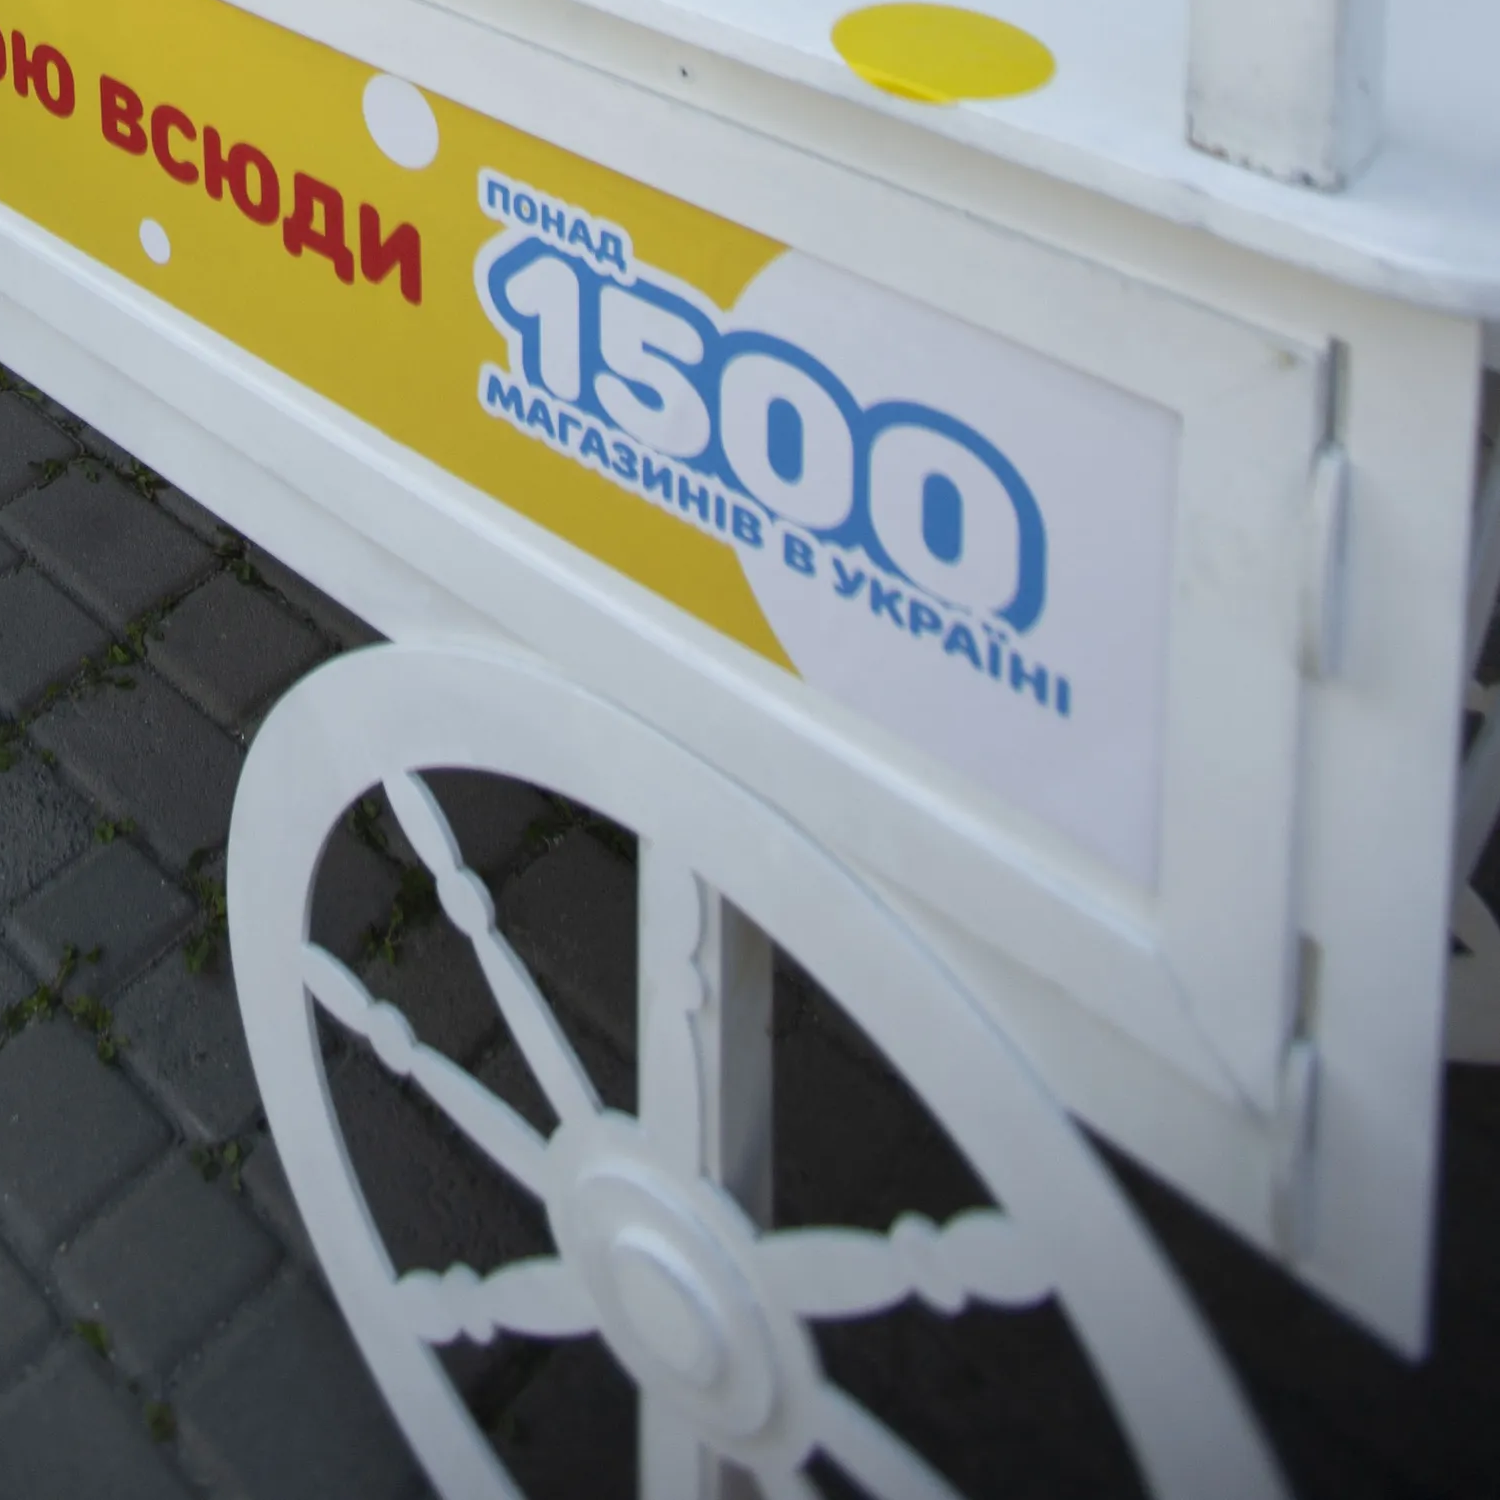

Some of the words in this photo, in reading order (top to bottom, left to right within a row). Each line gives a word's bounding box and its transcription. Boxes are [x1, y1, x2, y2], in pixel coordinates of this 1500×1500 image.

[99, 73, 423, 307] ВСЮДИ
[485, 178, 627, 273] ПОНАД
[485, 374, 764, 550] МАГАЗИНІВ
[782, 530, 817, 577] В
[830, 555, 1073, 719] УКРАЇНІ
[487, 236, 1048, 635] 1500
